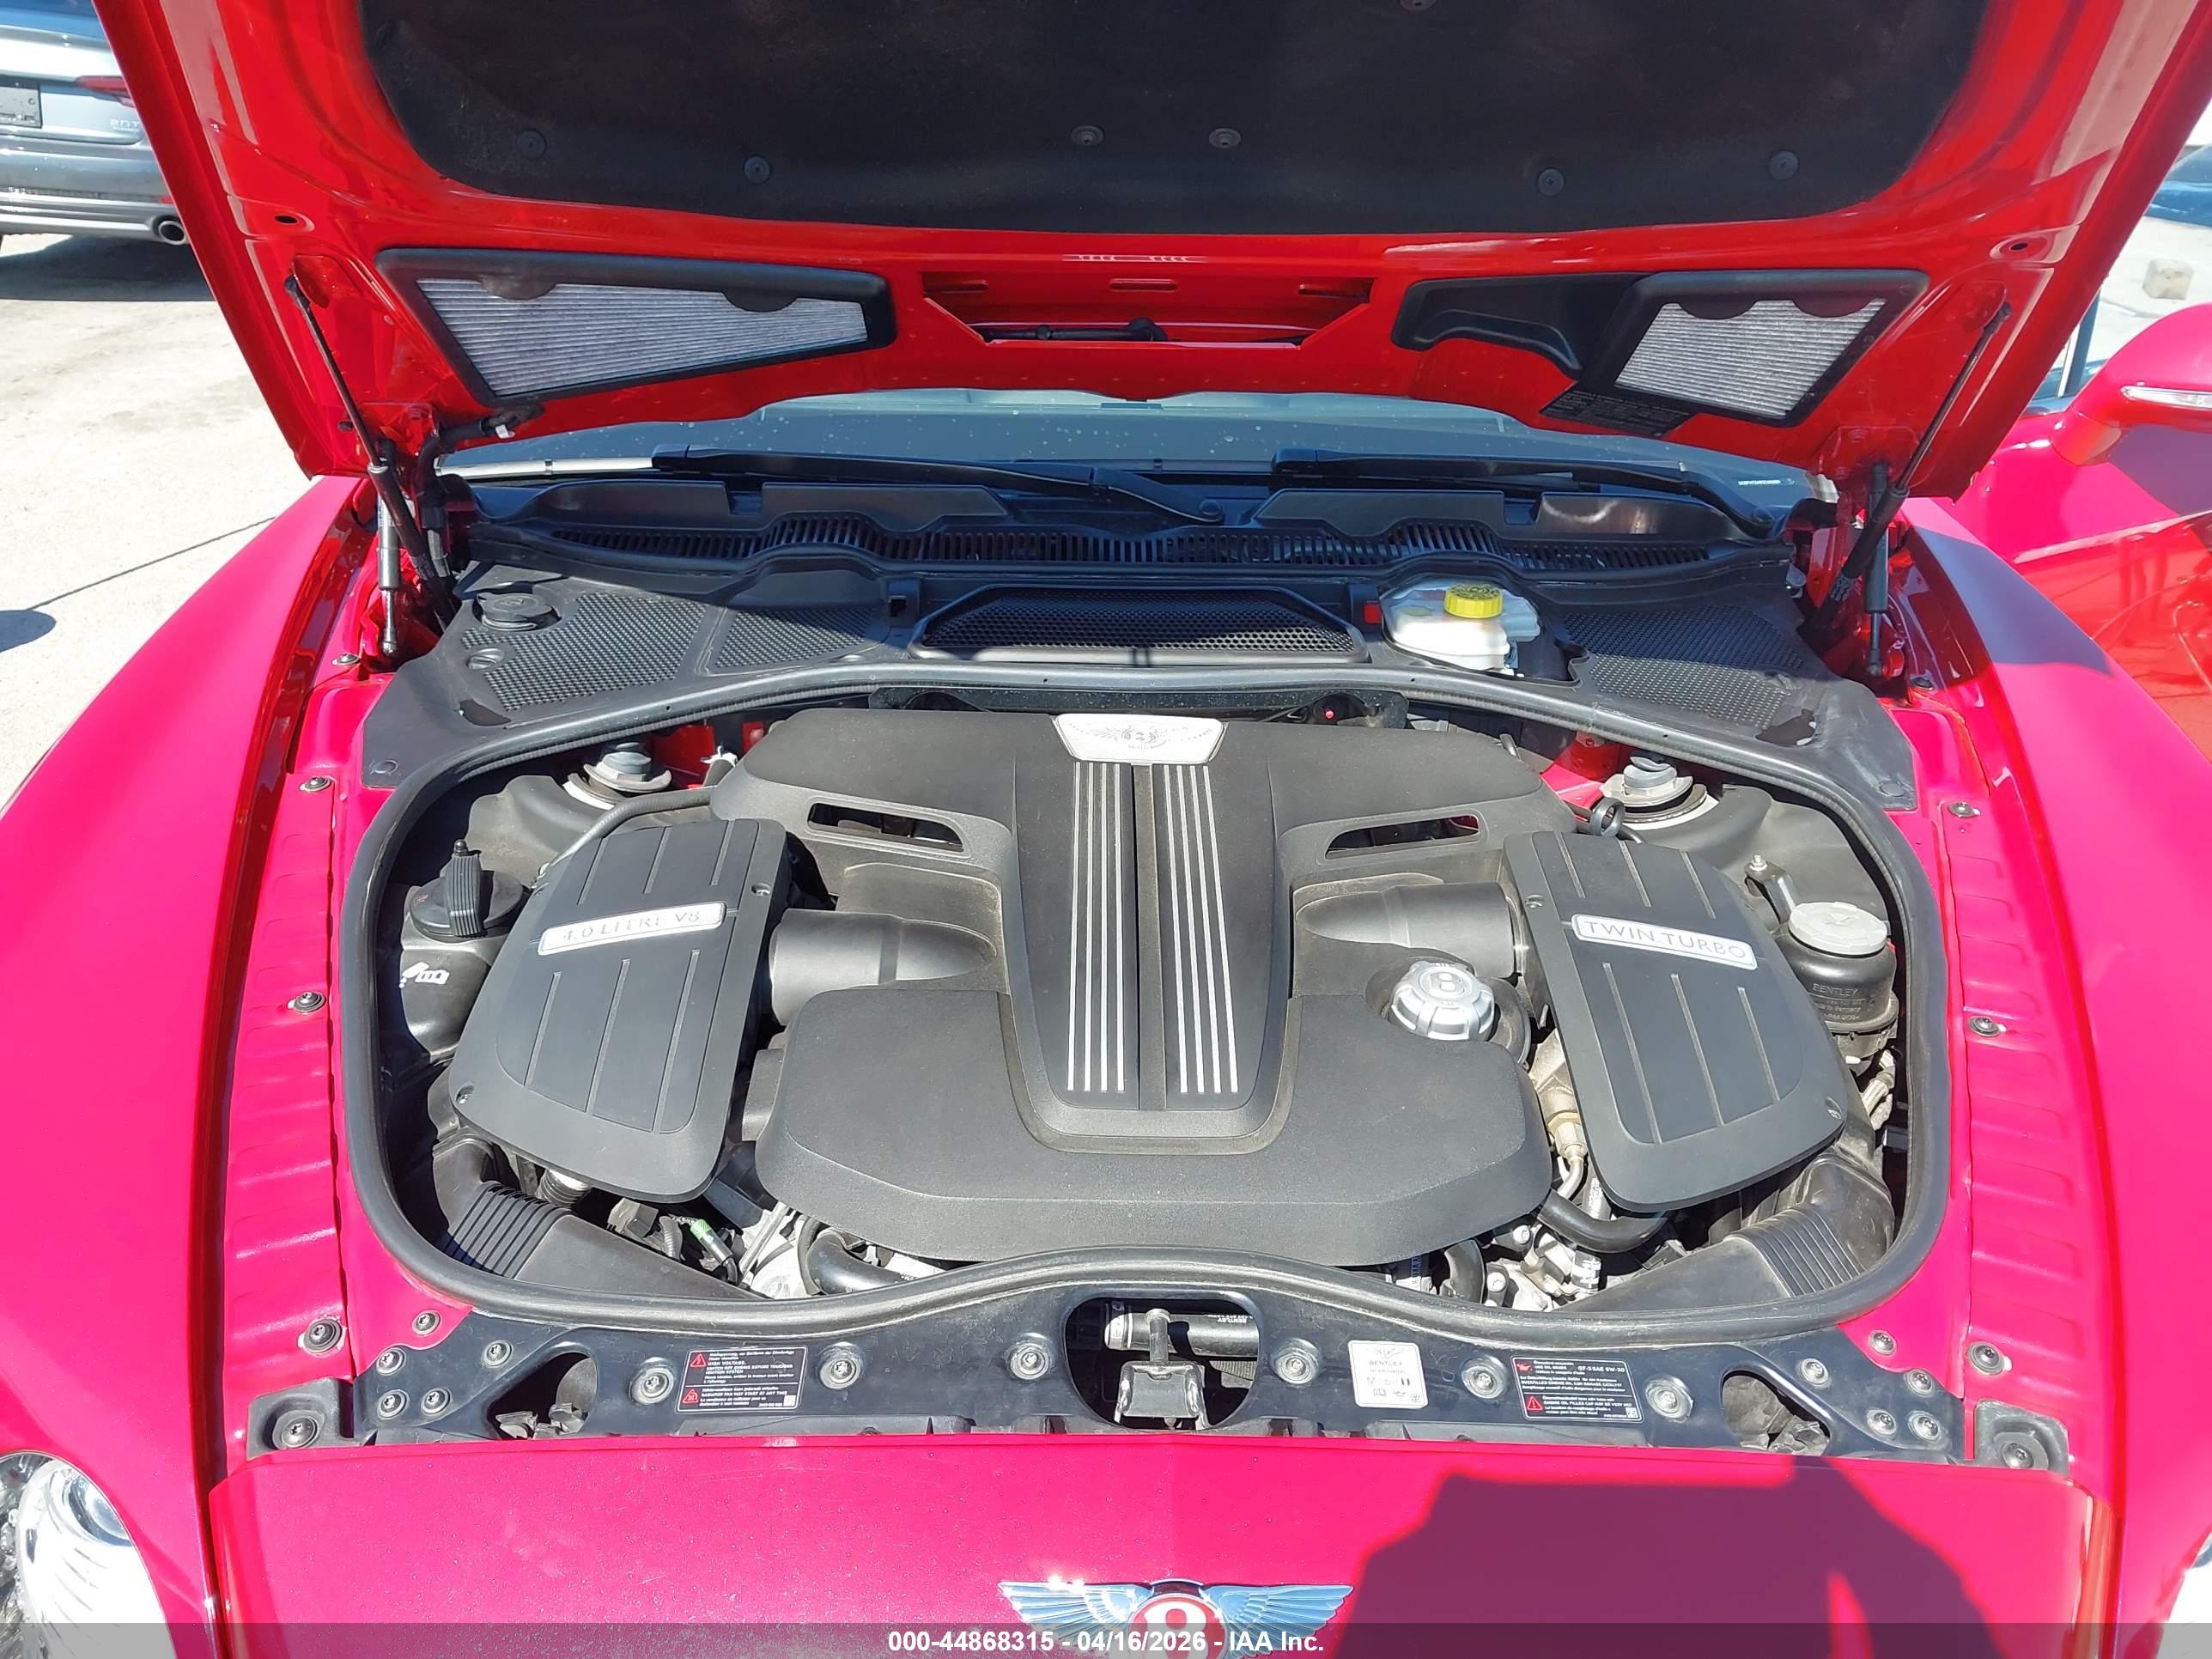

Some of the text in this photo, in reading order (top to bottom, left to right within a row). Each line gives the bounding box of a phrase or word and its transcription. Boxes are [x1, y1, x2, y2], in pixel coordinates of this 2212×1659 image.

[675, 910, 701, 923] V8
[1584, 921, 1747, 959] TWIN TURBO
[1813, 982, 1860, 996] BENTLEY
